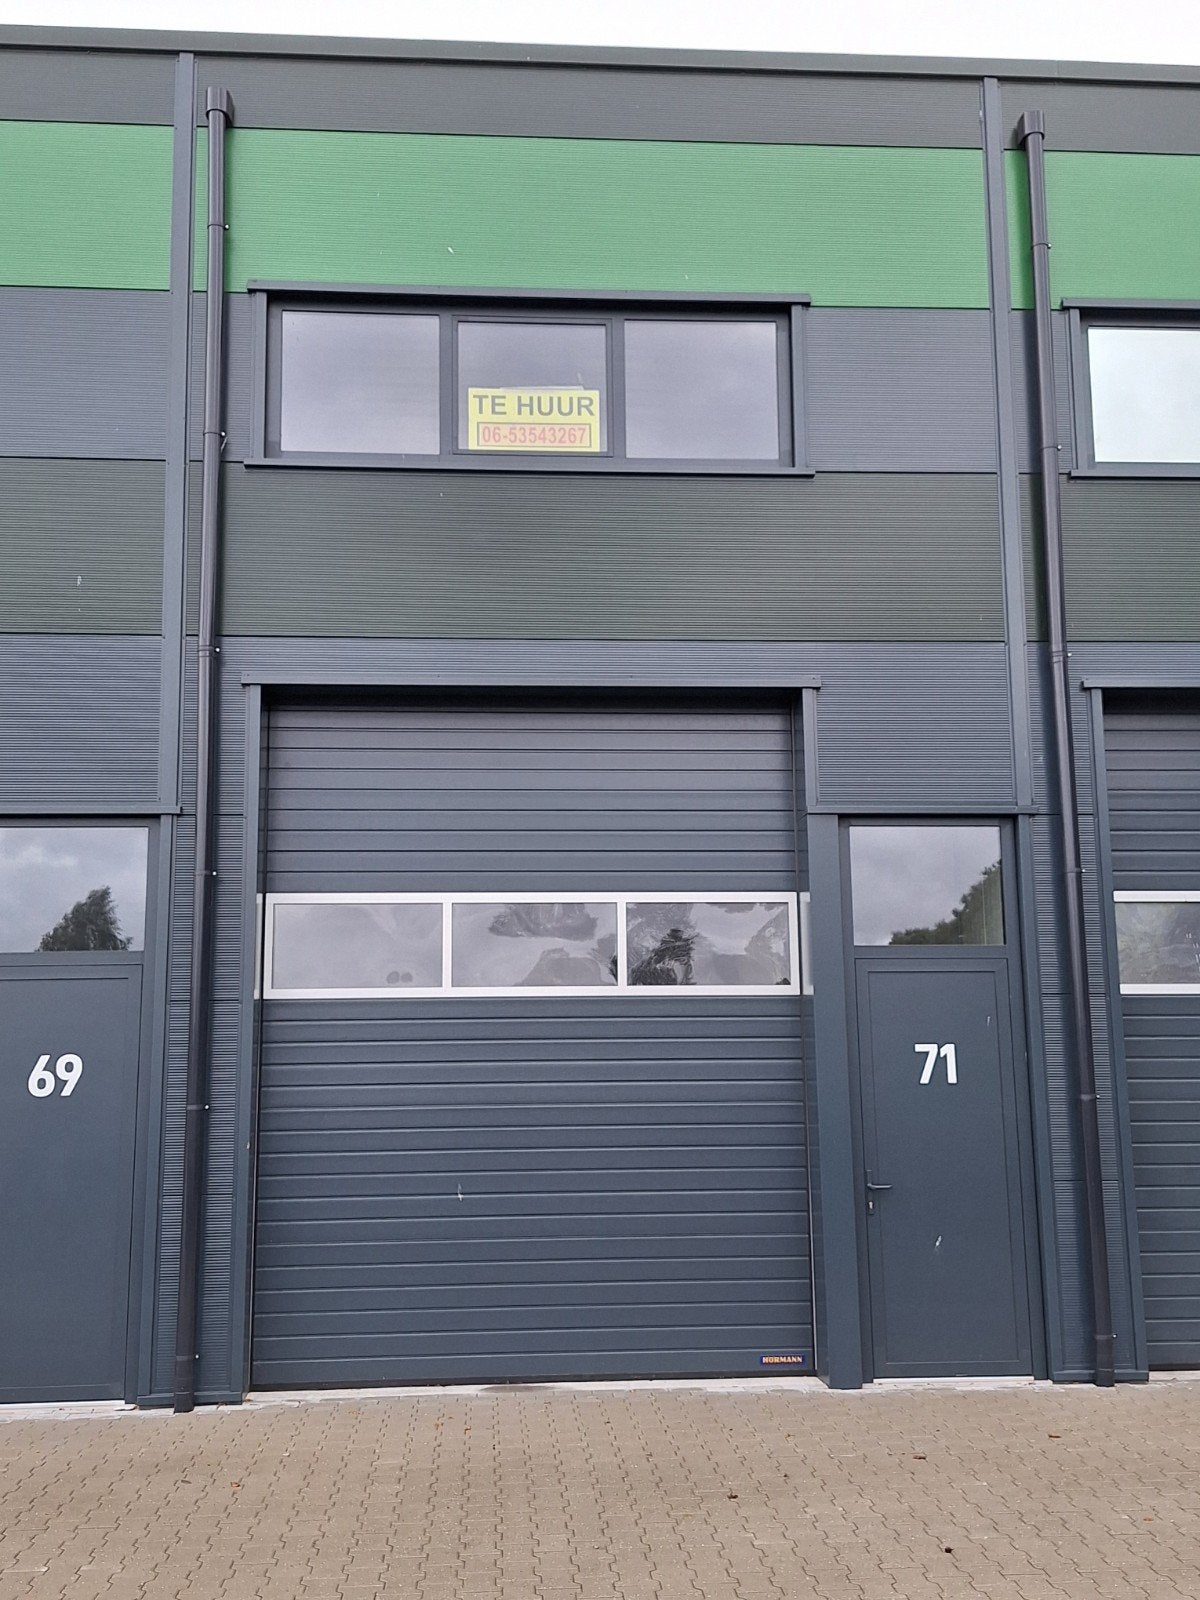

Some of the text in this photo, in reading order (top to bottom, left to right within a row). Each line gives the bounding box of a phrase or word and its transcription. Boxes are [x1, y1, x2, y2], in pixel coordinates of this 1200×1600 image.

[472, 394, 595, 416] TE HUUR
[482, 425, 587, 444] 06-53543267
[27, 1053, 83, 1098] 69
[914, 1043, 958, 1084] 71
